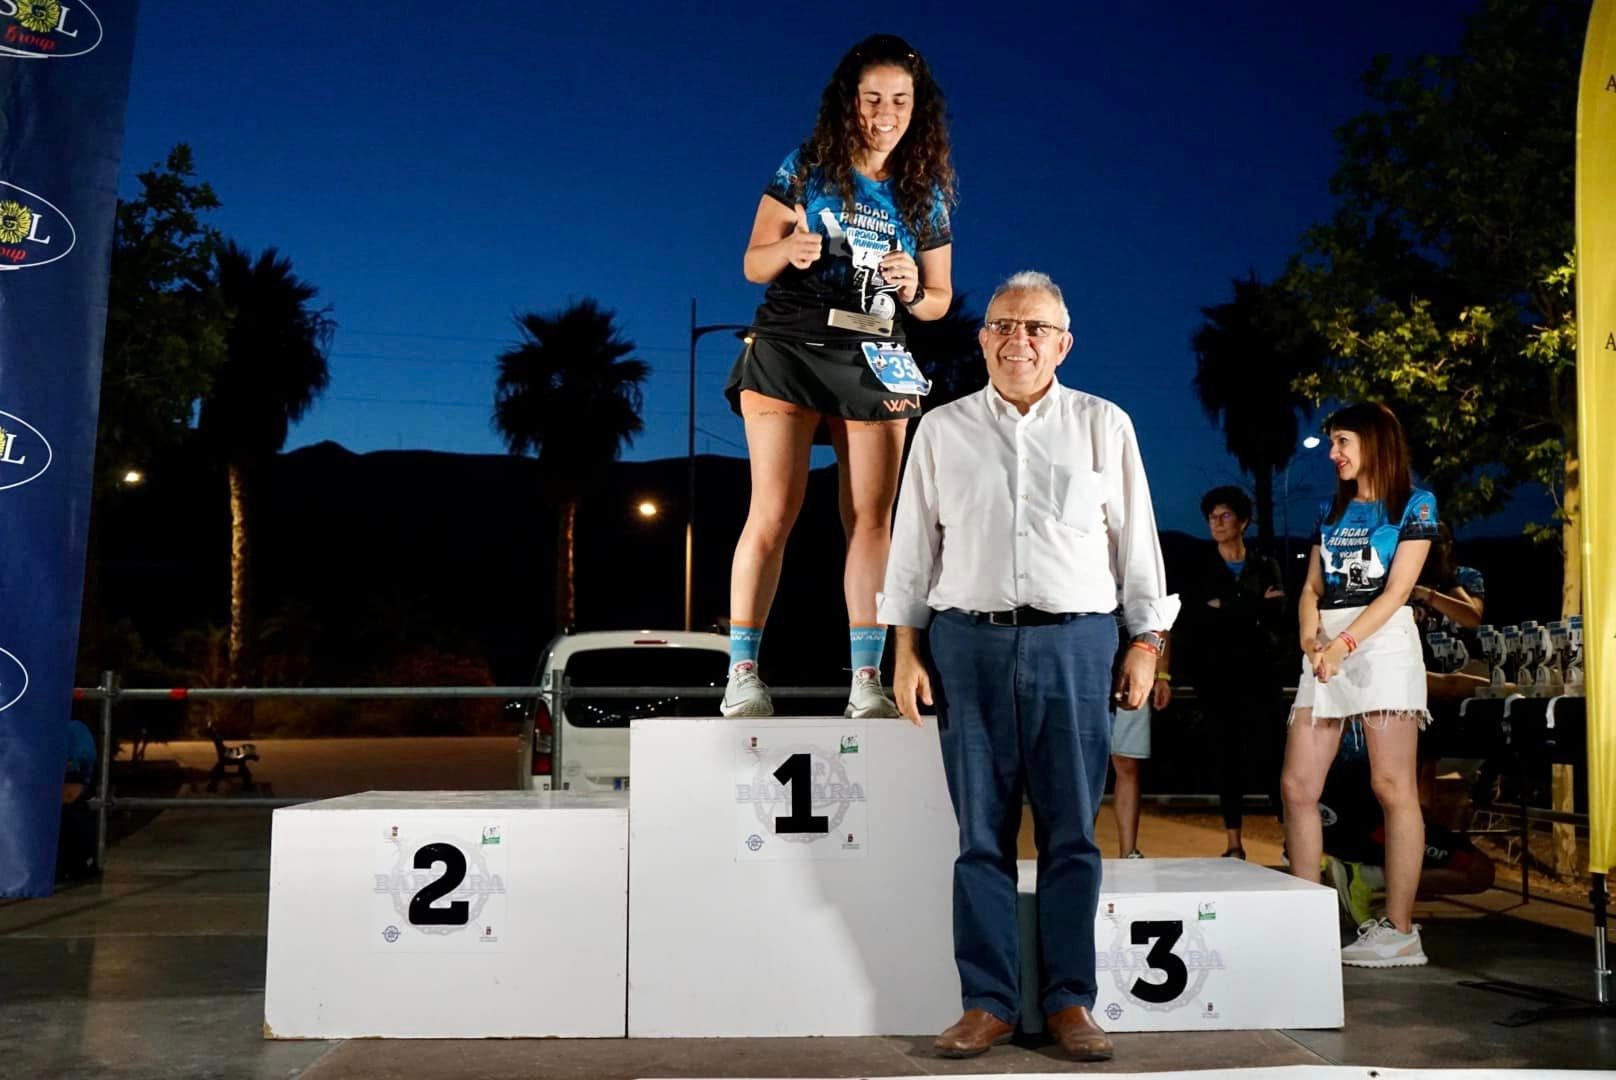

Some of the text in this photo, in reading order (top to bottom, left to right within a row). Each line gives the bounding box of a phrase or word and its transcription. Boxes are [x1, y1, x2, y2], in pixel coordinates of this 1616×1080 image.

[855, 202, 889, 220] ROAD
[1341, 528, 1369, 536] ROAD
[772, 753, 829, 834] 1
[408, 842, 469, 925] 2
[1130, 920, 1188, 1003] 3
